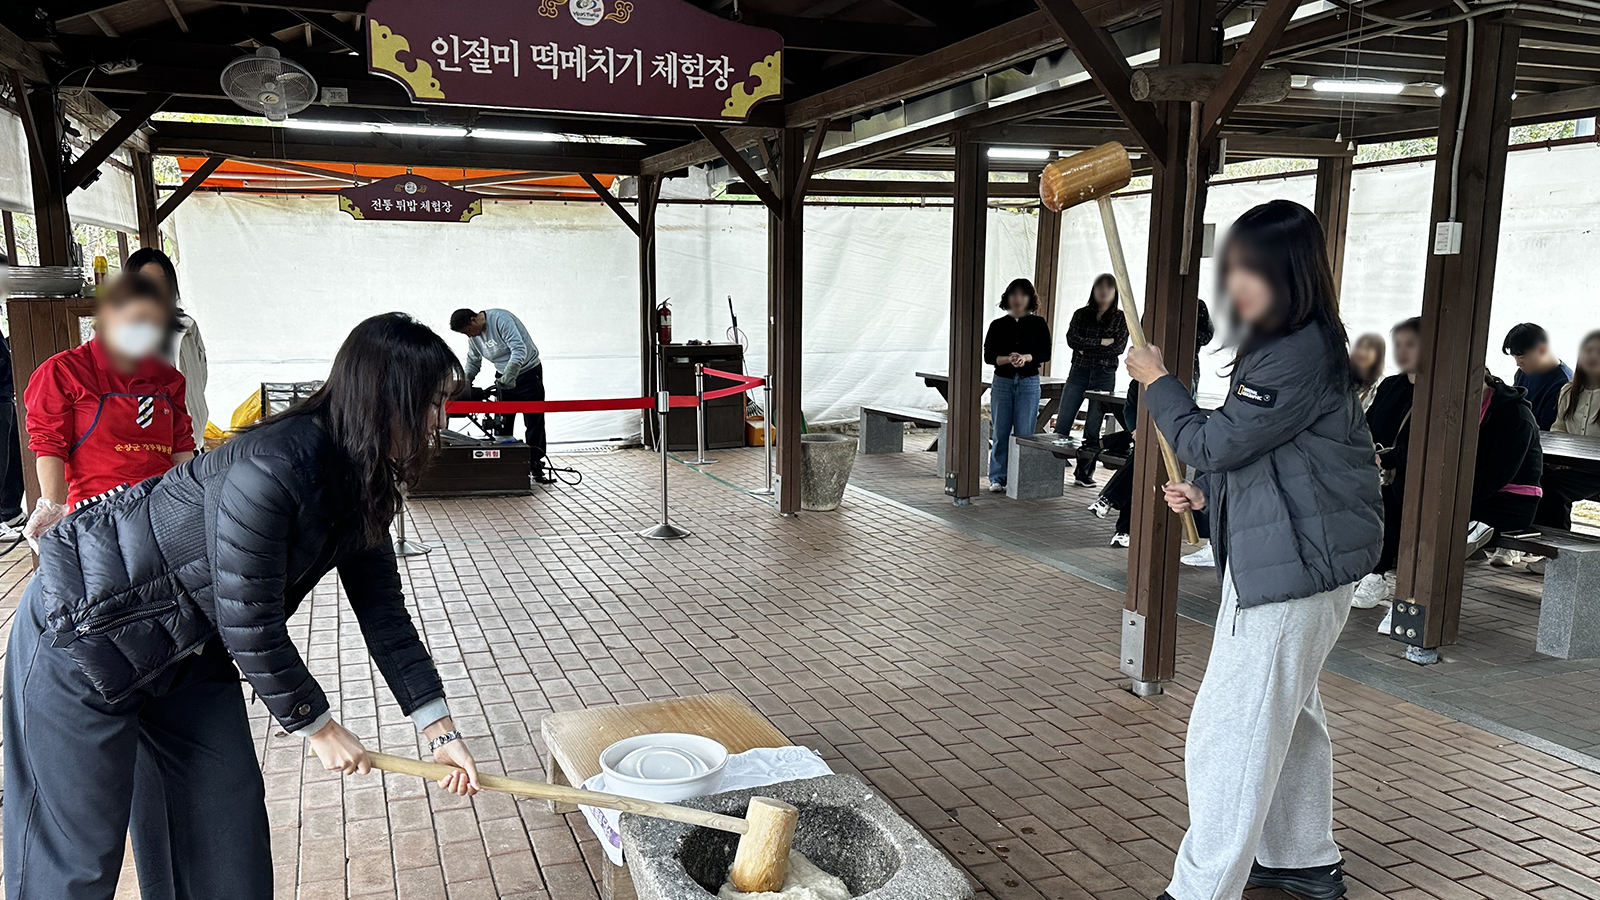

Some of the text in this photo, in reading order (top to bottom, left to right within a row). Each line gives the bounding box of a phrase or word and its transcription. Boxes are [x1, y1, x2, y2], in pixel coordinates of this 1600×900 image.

[431, 34, 735, 91] 인절미 떡메치기 체험장
[371, 198, 453, 213] 전통 튀밥 체험장
